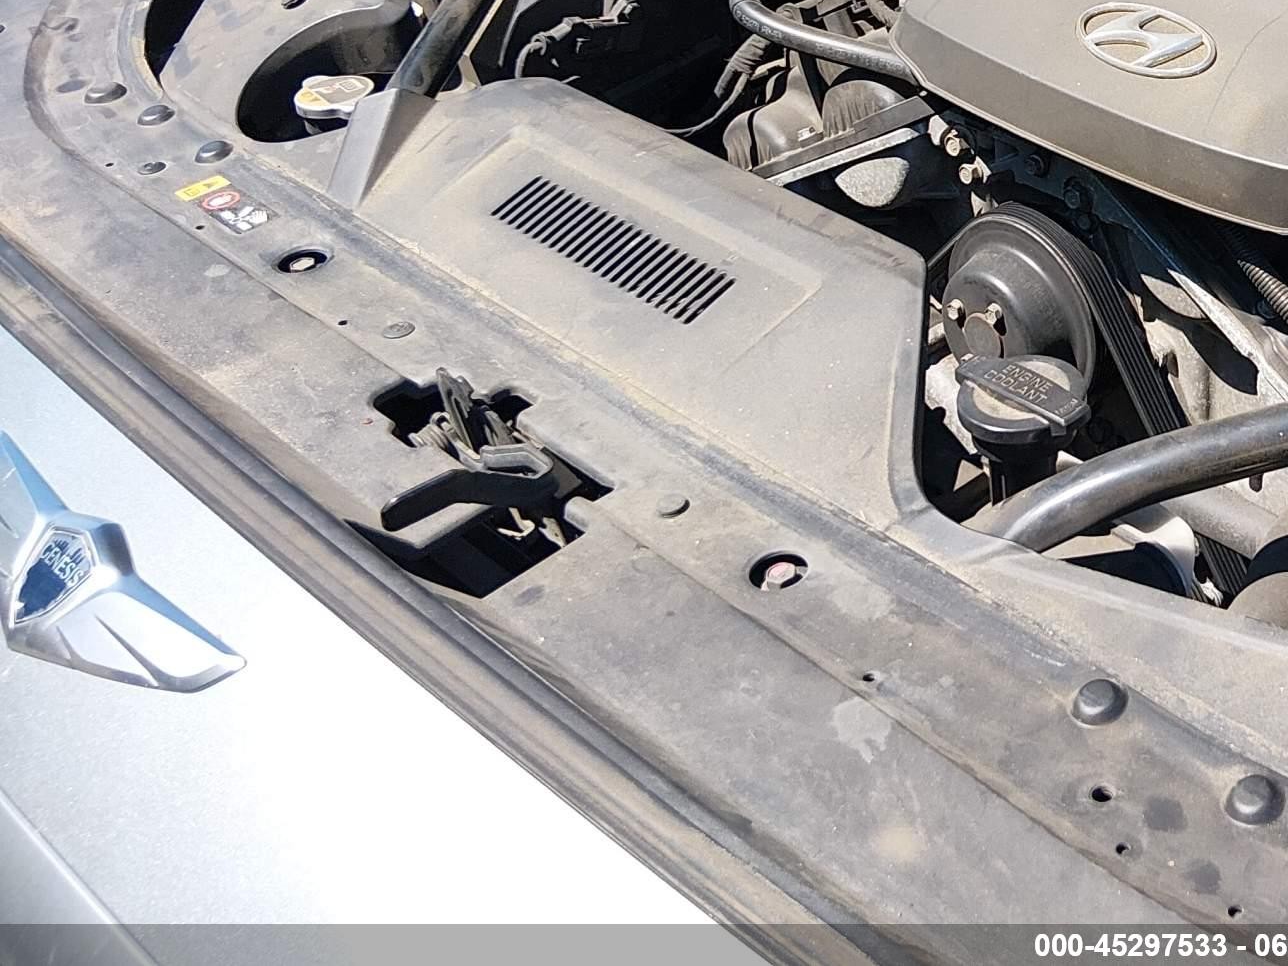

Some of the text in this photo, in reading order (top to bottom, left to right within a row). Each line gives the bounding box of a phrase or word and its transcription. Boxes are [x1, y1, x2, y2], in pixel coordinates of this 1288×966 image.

[983, 369, 1048, 404] COOLANT
[1001, 364, 1054, 393] ENGINE
[41, 542, 84, 587] GENESIS
